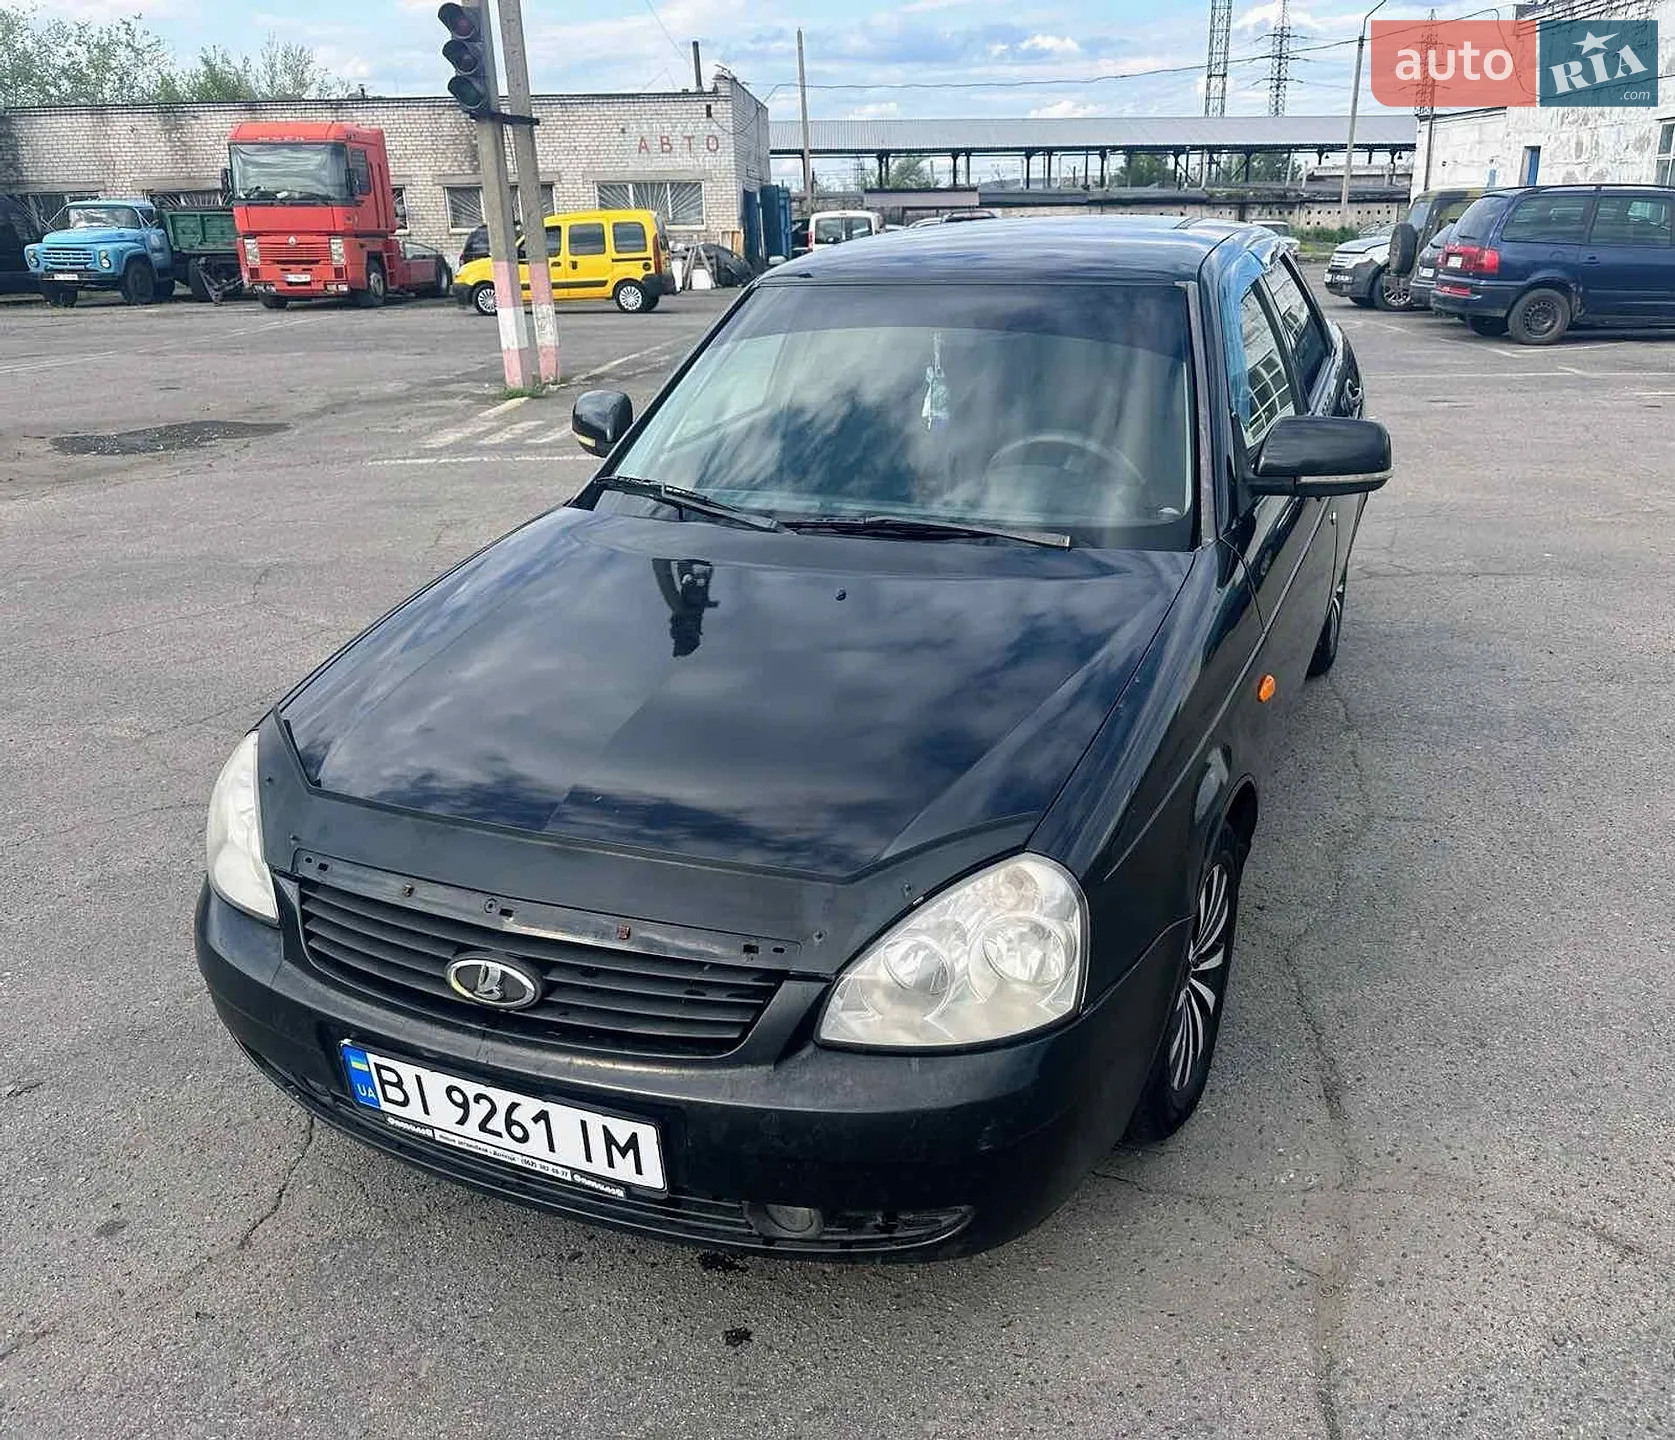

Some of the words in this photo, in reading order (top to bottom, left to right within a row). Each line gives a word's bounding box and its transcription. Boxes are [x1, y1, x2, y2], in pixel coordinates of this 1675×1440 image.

[638, 135, 719, 154] АВТО
[358, 1084, 376, 1100] UA
[374, 1062, 430, 1116] BI
[444, 1084, 556, 1153] 9261
[580, 1118, 644, 1176] IM
